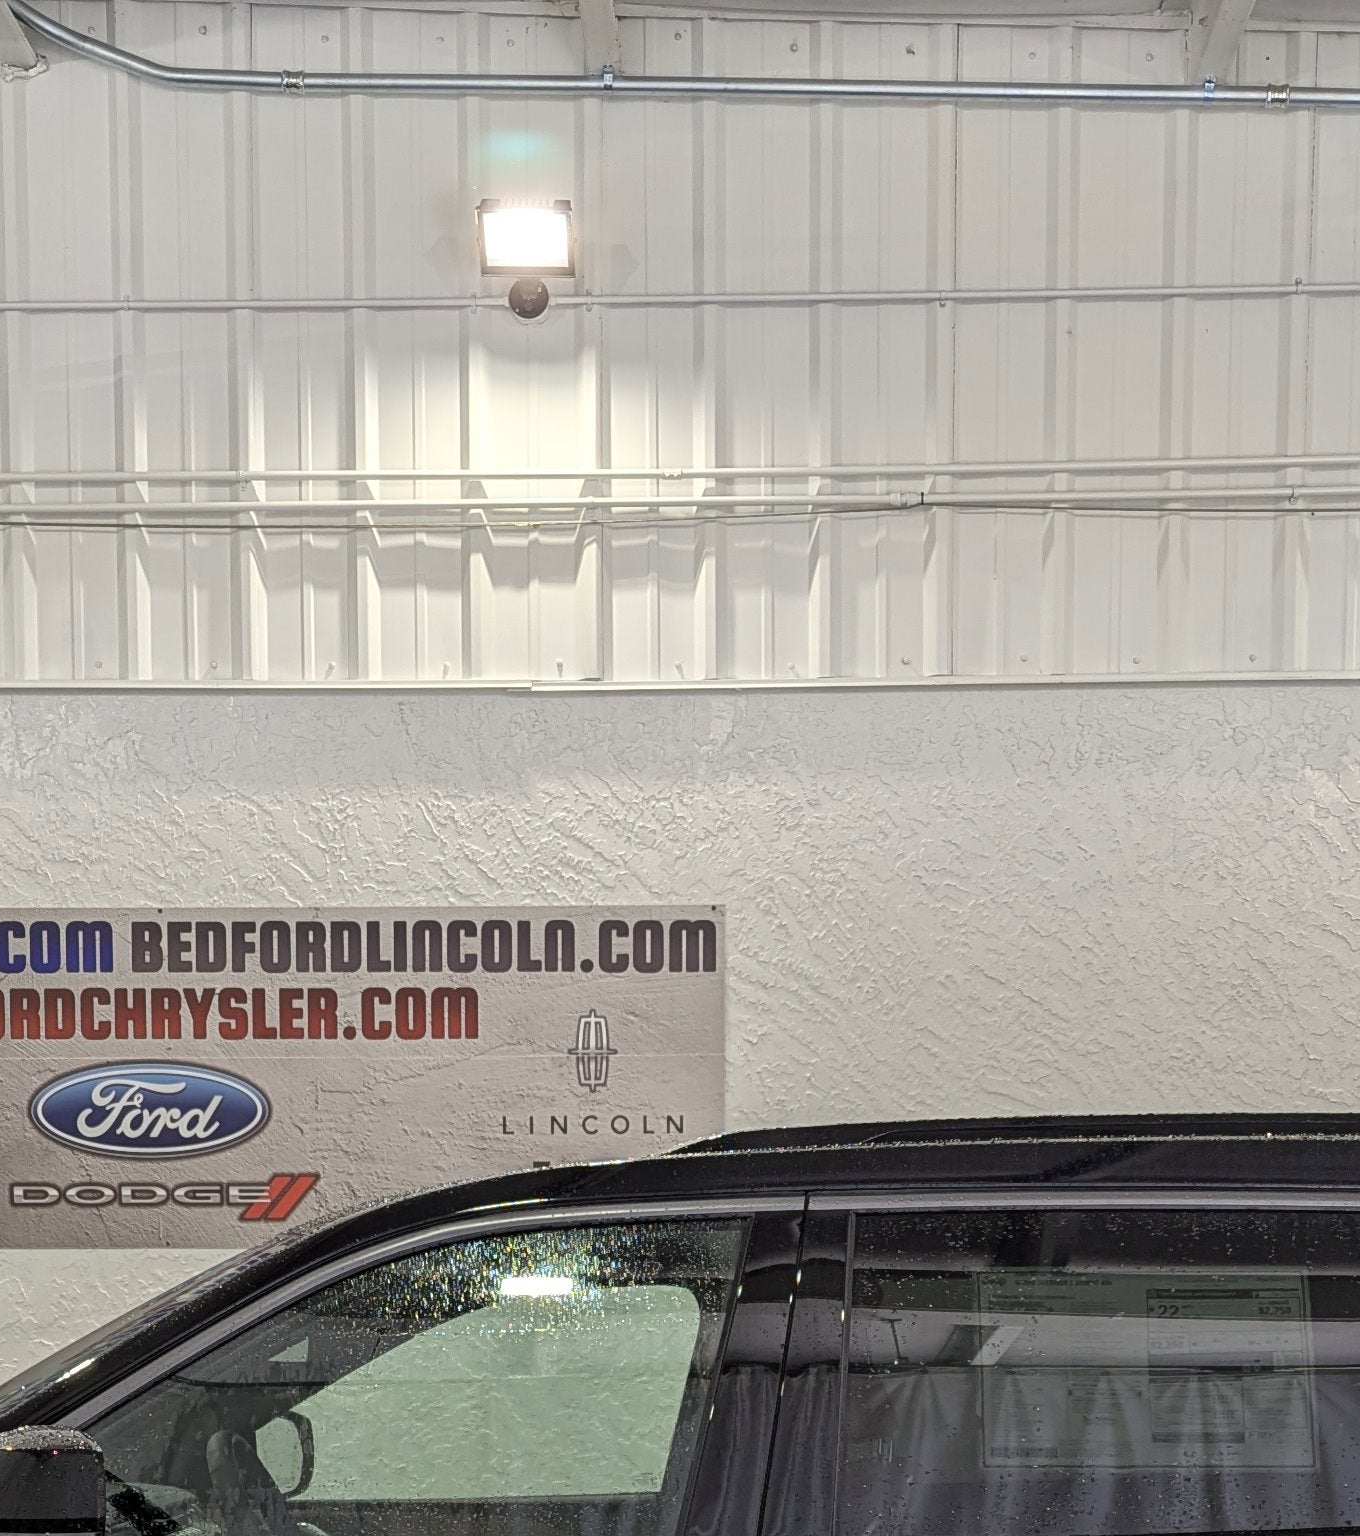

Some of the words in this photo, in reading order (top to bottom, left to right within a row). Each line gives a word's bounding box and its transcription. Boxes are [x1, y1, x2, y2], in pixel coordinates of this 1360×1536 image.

[130, 918, 716, 974] BEDFORDLINCOLN.COM
[77, 1079, 223, 1139] Ford
[502, 1115, 684, 1135] LINCOLN
[10, 1183, 271, 1205] DODGE
